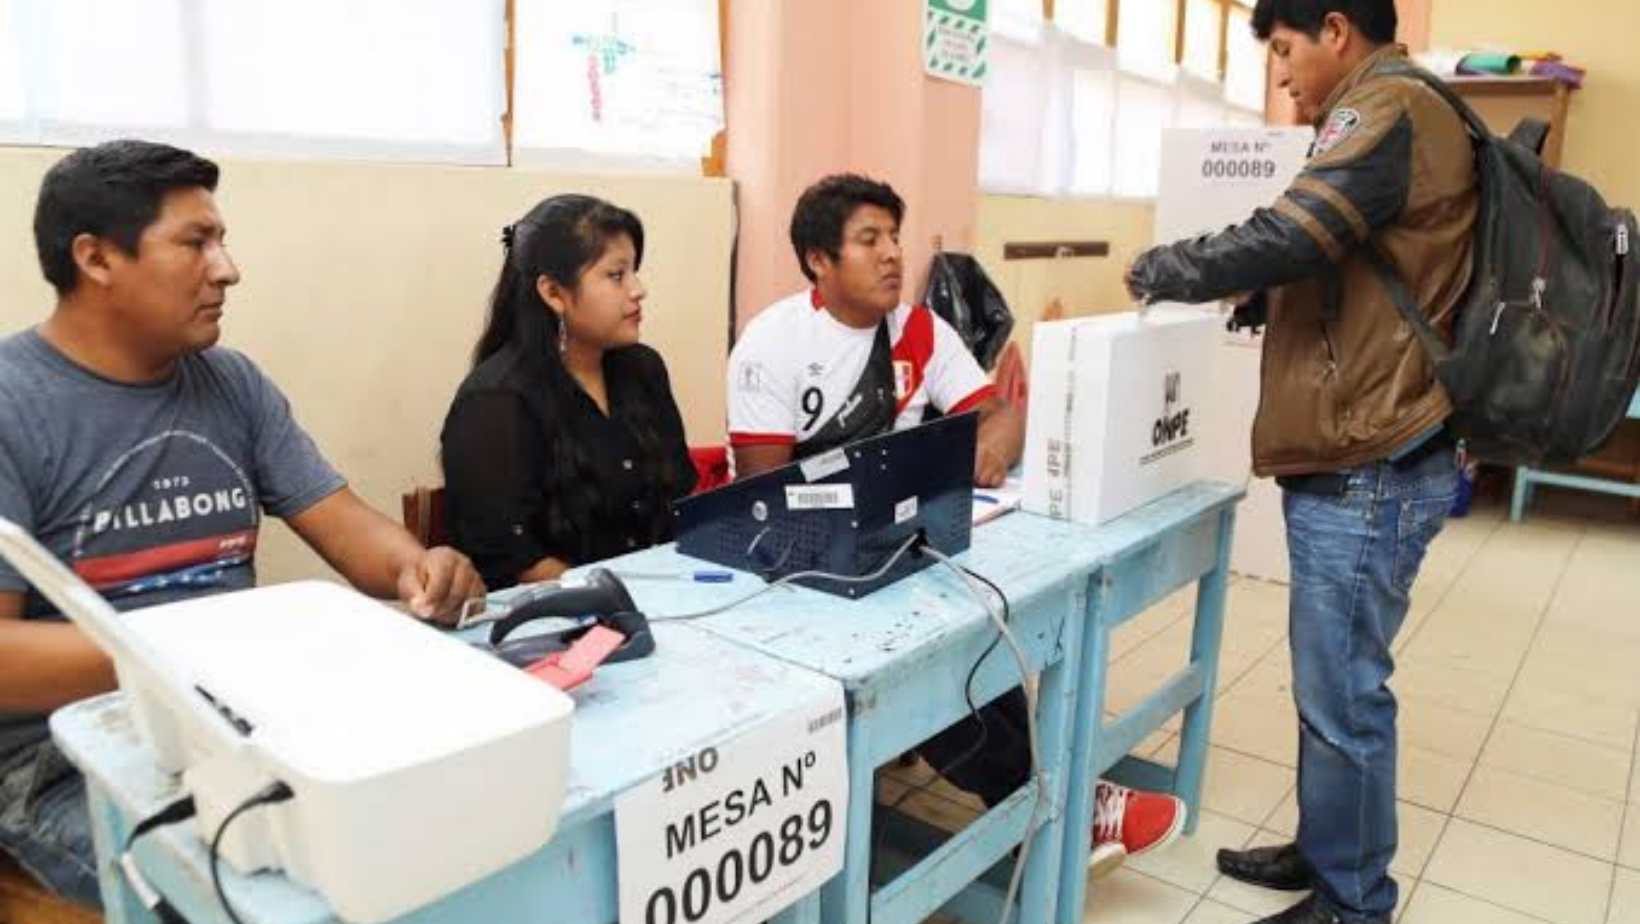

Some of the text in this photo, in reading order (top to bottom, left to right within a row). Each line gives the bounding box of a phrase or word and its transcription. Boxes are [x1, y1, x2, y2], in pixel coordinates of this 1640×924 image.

[1202, 159, 1275, 179] 000089
[802, 386, 824, 431] 9
[1152, 408, 1191, 448] ONPE
[665, 777, 772, 860] MESA
[645, 799, 833, 924] 000089
